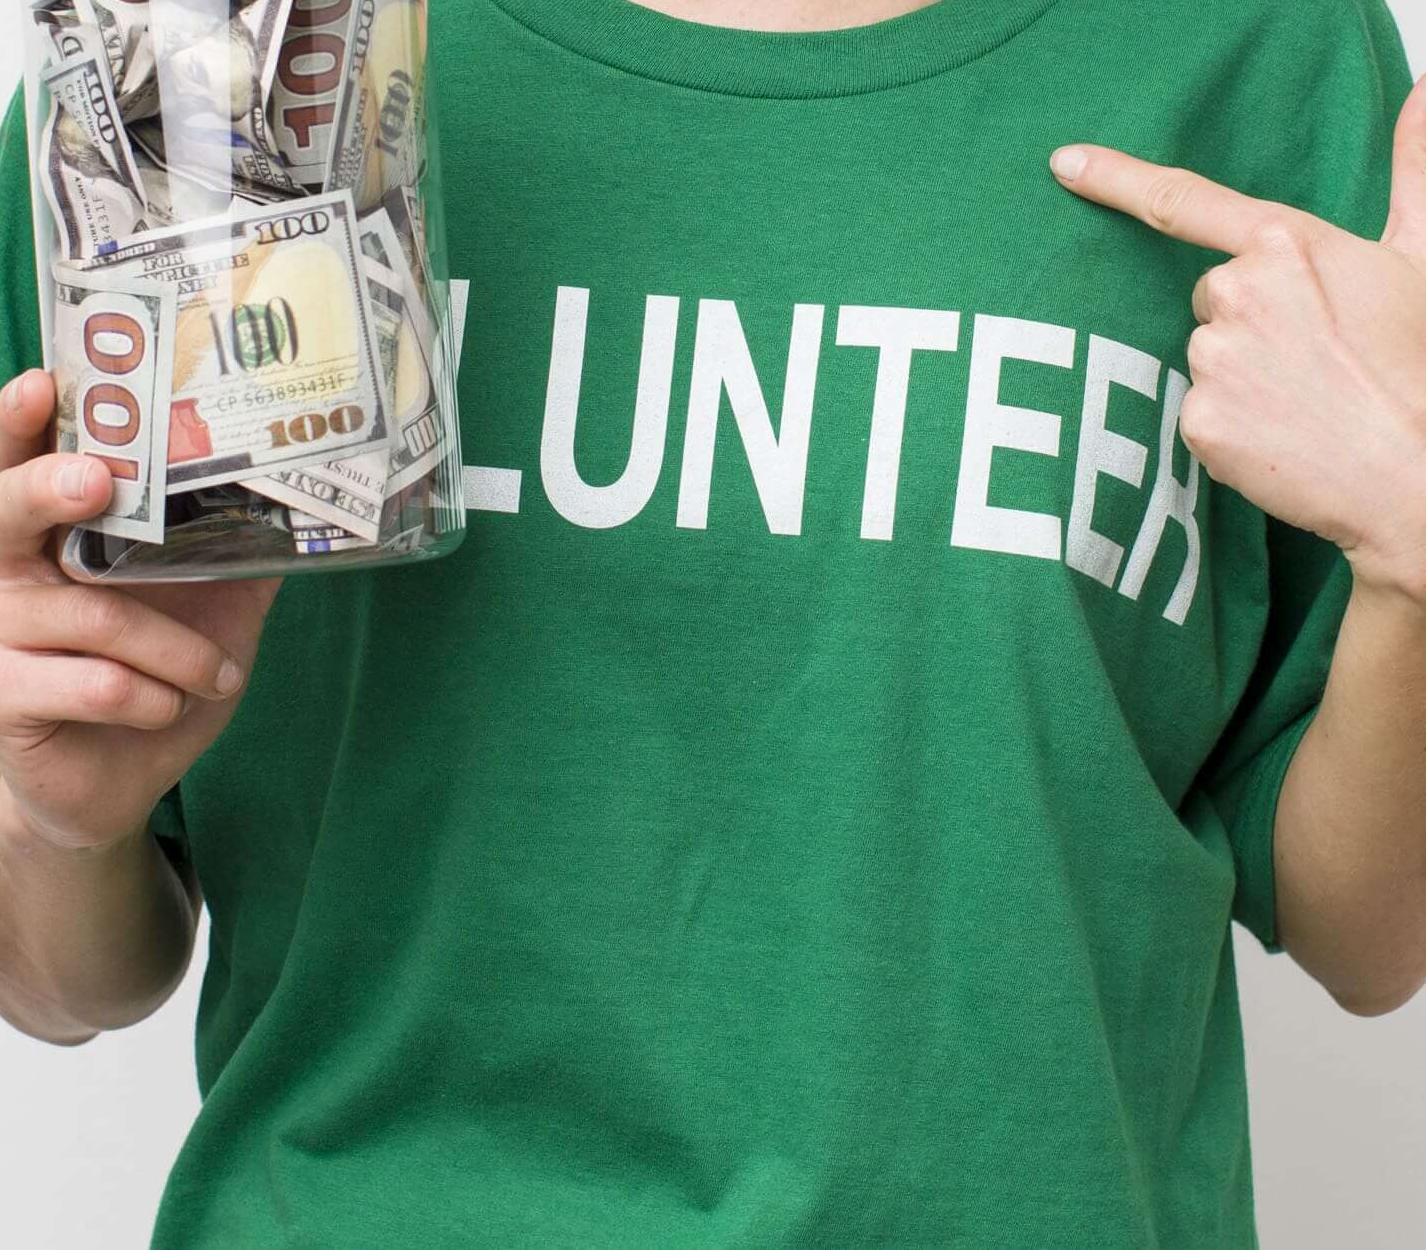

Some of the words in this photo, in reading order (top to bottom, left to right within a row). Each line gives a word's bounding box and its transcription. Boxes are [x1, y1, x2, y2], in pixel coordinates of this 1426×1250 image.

[254, 211, 330, 245] 100
[142, 253, 184, 272] FOR
[210, 296, 300, 377] 100
[83, 312, 146, 482] 100
[269, 405, 365, 448] 100
[448, 278, 1201, 626] LUNTEER
